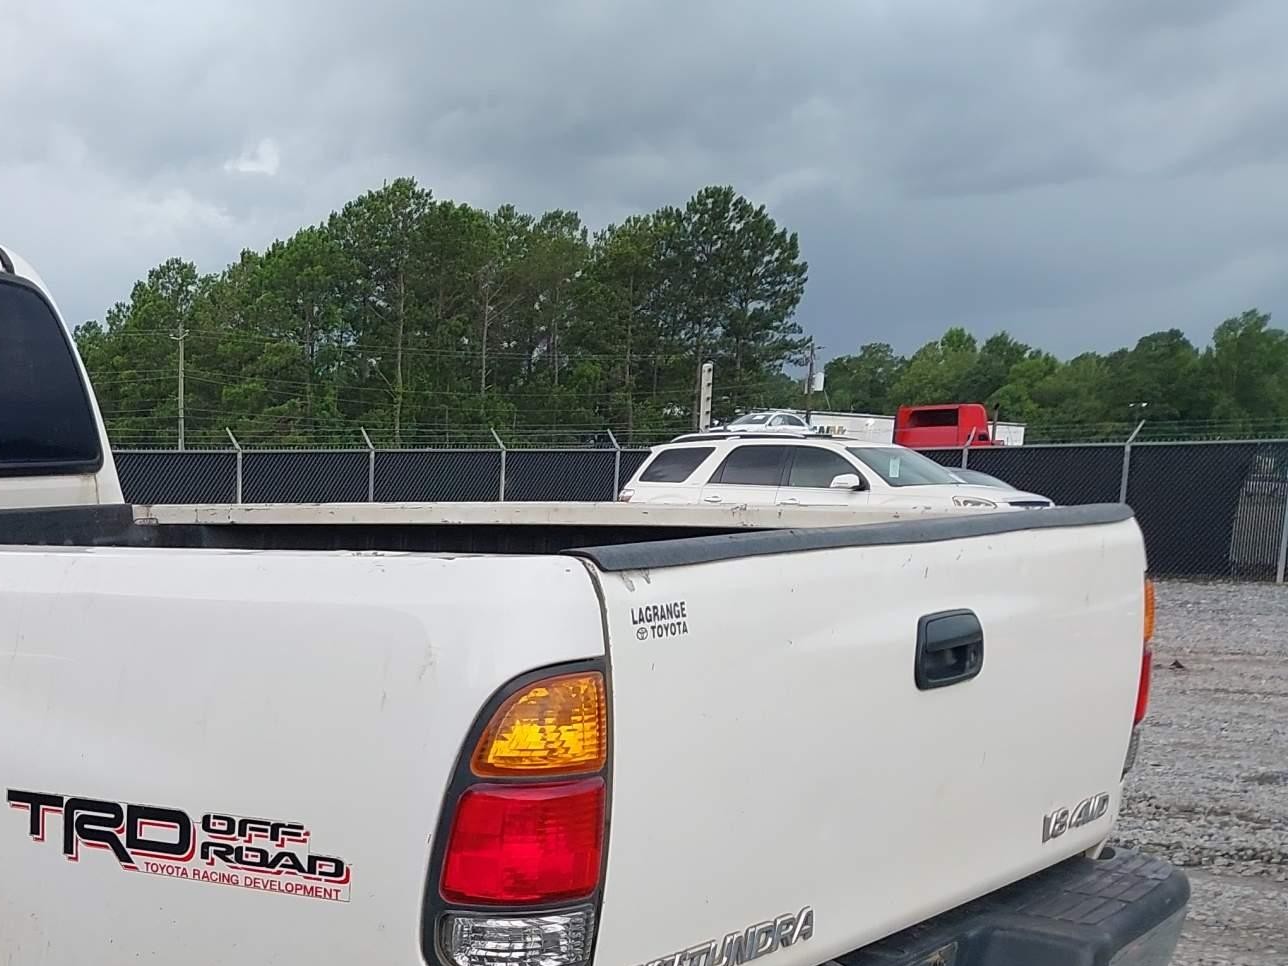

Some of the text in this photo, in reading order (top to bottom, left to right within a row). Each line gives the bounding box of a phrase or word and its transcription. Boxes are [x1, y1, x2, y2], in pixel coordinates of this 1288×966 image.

[631, 601, 687, 625] LAGRANGE
[650, 621, 689, 639] TOYOTA
[6, 788, 197, 871] TRD
[201, 813, 310, 848] OFF
[1041, 806, 1069, 844] V8
[144, 861, 341, 900] TOYOTA RACING DEVELOPMENT
[200, 841, 351, 884] ROAD
